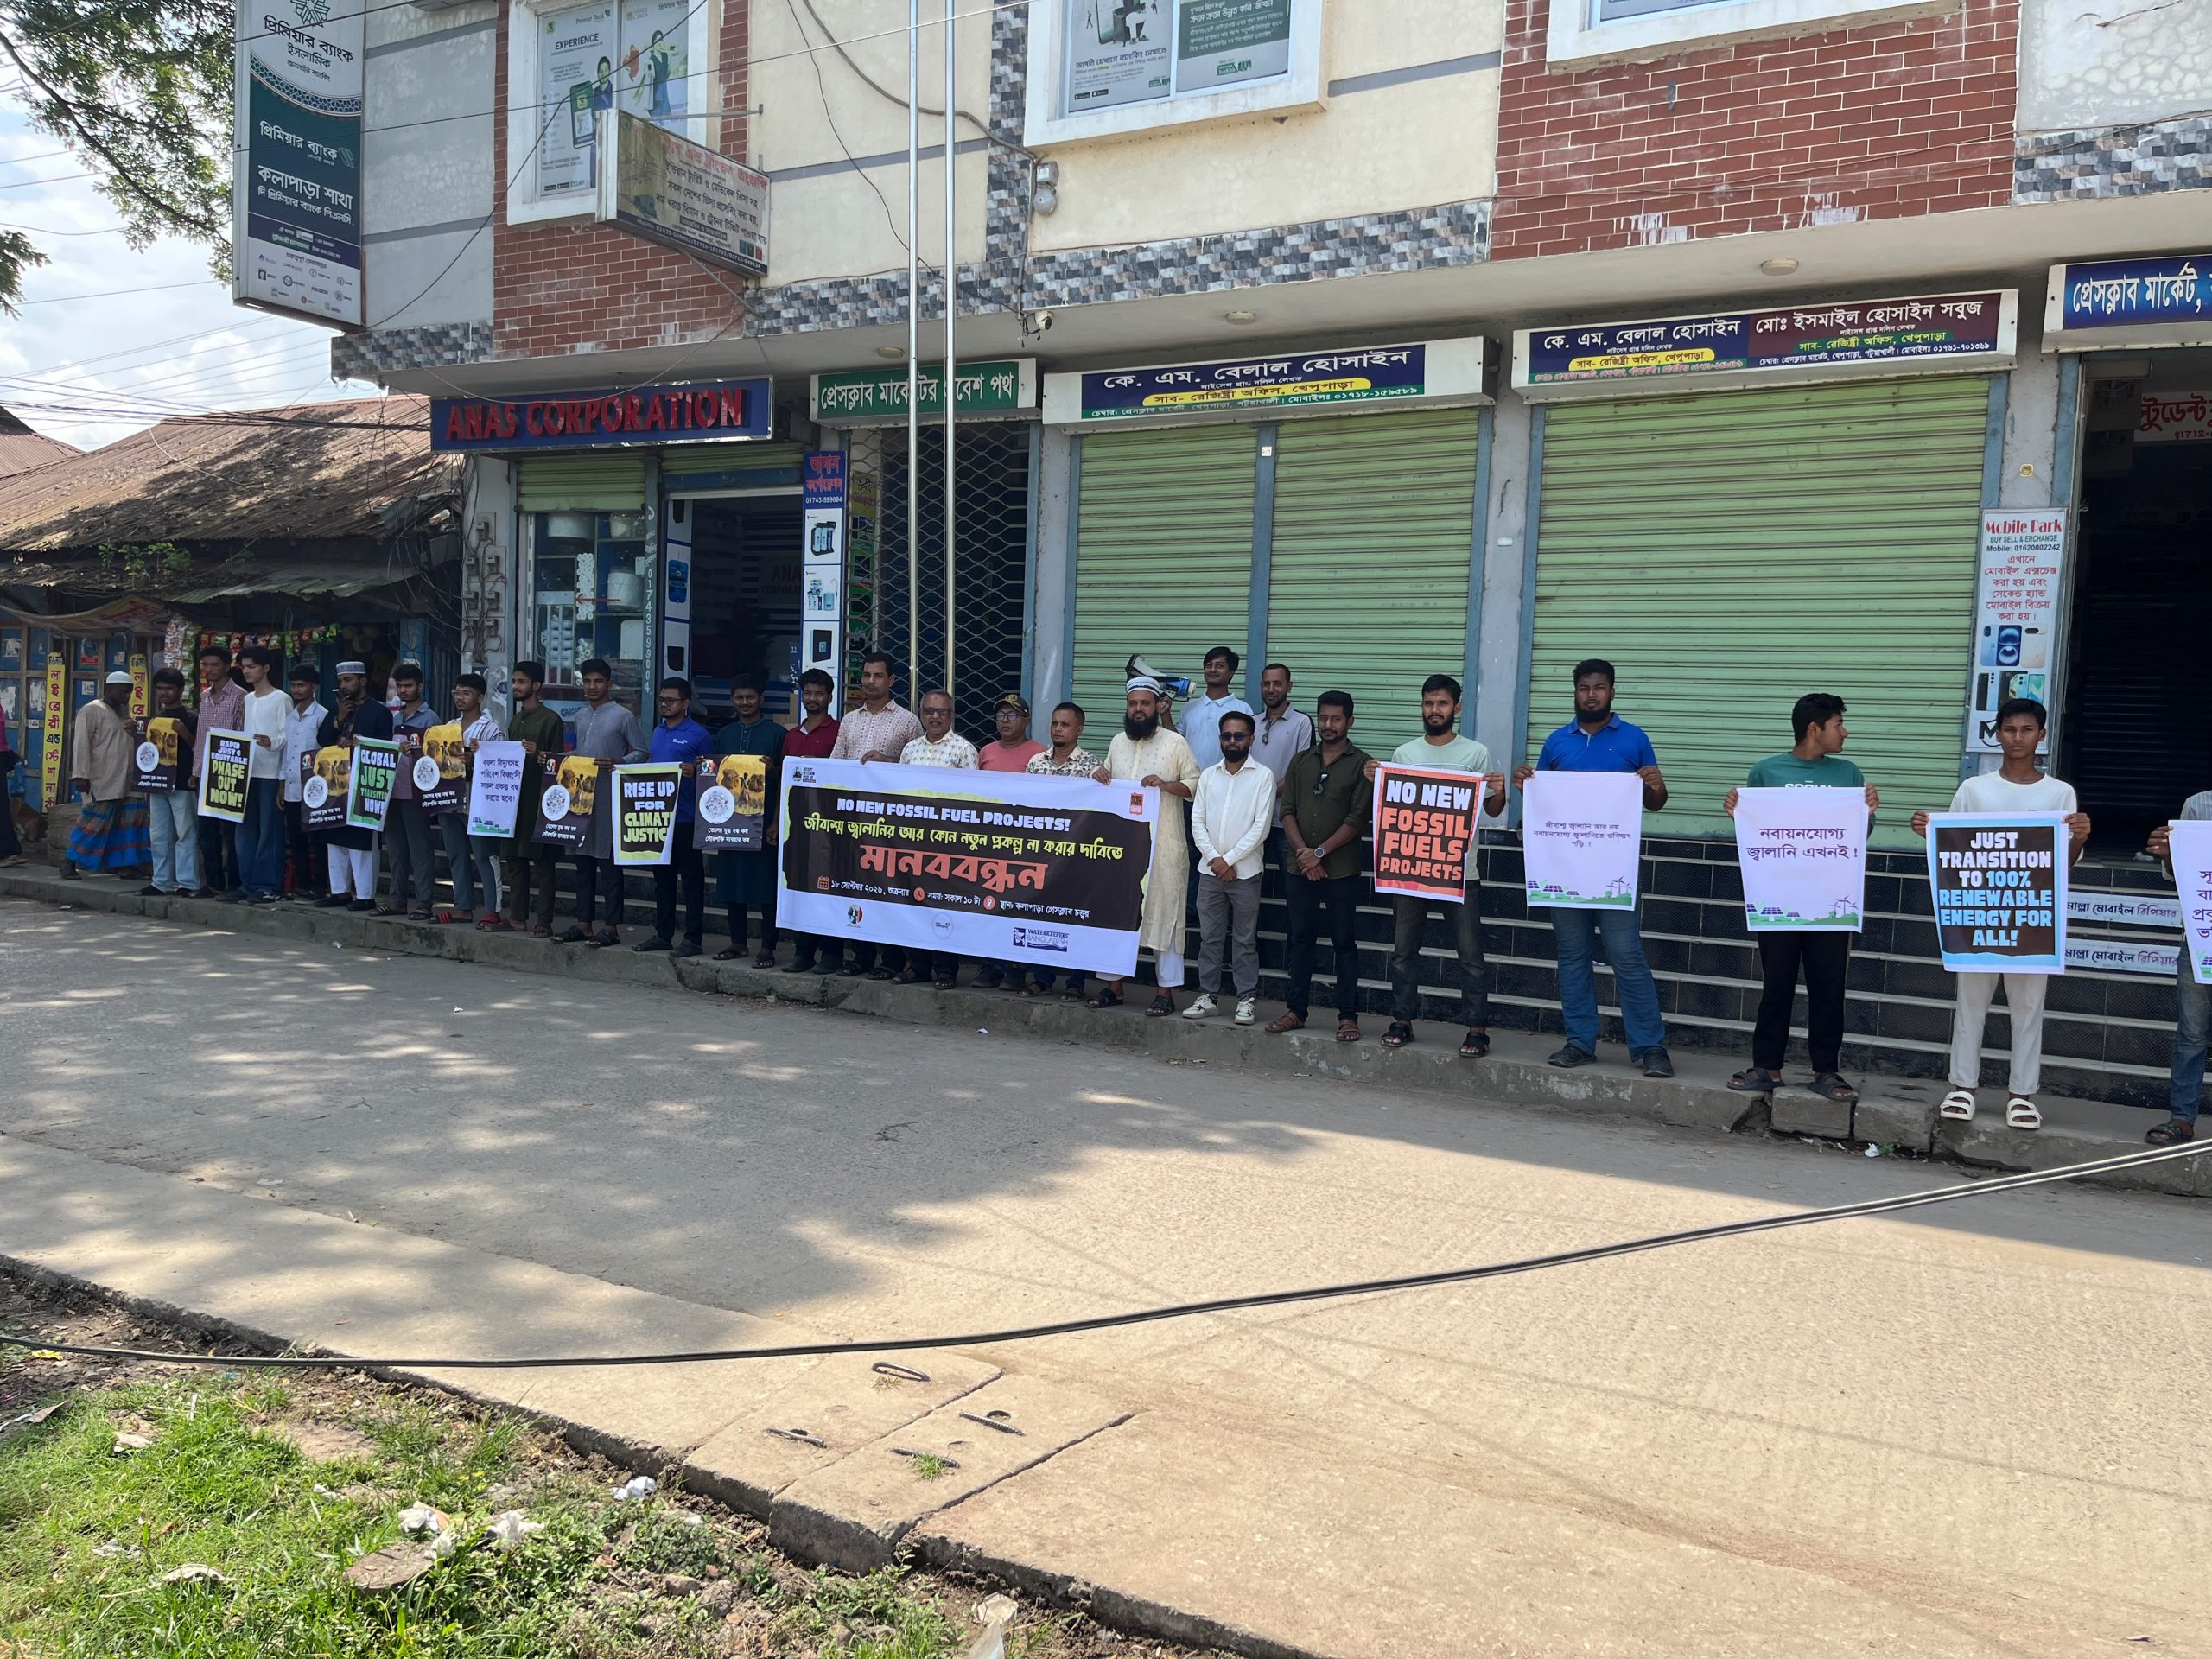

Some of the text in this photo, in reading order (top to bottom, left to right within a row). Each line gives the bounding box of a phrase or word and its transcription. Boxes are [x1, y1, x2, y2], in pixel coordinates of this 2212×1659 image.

[264, 15, 354, 62] প্রিমিয়ার ব্যাংক
[555, 34, 599, 50] EXPERIENCE
[287, 42, 331, 68] ইসলামিক
[259, 120, 303, 149] প্রিমিয়ার
[308, 141, 338, 161] ব্যাংক
[258, 165, 353, 210] কলাপাড়া শাখা
[258, 186, 322, 214] দি প্রিমিয়ার ব্যাংক
[2074, 262, 2202, 315] প্রেসক্লাব মার্কেট,
[1756, 300, 1983, 334] মোঃ ইসমাইল হোসাইন সবুজ
[1544, 318, 1741, 350] কে. এম. বেলাল হোসাইন
[1901, 330, 1946, 346] খেপুপাড়া
[1664, 351, 1705, 364] খেপুপাড়া
[1103, 350, 1412, 389] কে. এম. বেলাল হোসাইন
[821, 382, 875, 410] প্রেসক্লাব
[990, 370, 1014, 401] পথ
[1292, 380, 1355, 394] খেপুপাড়া
[444, 387, 744, 441] ANAS CORPORATION
[1986, 518, 2063, 534] Mobile Park
[2007, 555, 2037, 563] এখানে
[1984, 565, 2020, 575] মোবাইল
[1993, 578, 2047, 588] করা হয় এবং
[1992, 589, 2046, 599] সেকেন্ড হ্যান্ড
[1986, 599, 2050, 610] মোবাইল বিক্রয়
[1998, 612, 2031, 621] করা হয়
[218, 747, 236, 755] JUST
[219, 739, 240, 748] RAPID
[211, 752, 248, 765] EQUITABLE
[360, 749, 397, 768] GLOBAL
[212, 760, 245, 779] PHASE
[360, 766, 396, 789] JUST
[217, 775, 238, 792] OUT
[624, 781, 675, 798] RISE UP
[210, 788, 244, 808] NOW!
[360, 788, 388, 800] TRANSITIO
[1386, 779, 1472, 810] NO NEW
[634, 800, 665, 810] FOR
[624, 812, 671, 827] CLIMAT
[836, 798, 1071, 832] NO NEW FOSSIL FUEL PROJECTS!
[1381, 806, 1469, 839] FOSSIL
[623, 827, 667, 842] JUSTIC
[804, 811, 1124, 860] জীবাশ্ম জ্বালানির আর কোন নতুন প্রকল্প না করার দাবিতে
[1758, 827, 1847, 841] নবায়নযোগ্য
[1969, 831, 2019, 849] JUST
[1383, 831, 1464, 862] FUELS
[1746, 843, 1798, 861] জ্বালানি
[859, 844, 1049, 893] মানববন্ধন
[1379, 856, 1463, 881] PROJECTS
[1938, 851, 2051, 868] TRANSITION
[1958, 870, 2031, 887] TO 100%
[944, 893, 963, 904] সকাল
[963, 895, 973, 905] ১০
[974, 895, 982, 906] টা
[1015, 901, 1045, 914] কলাপাড়া
[1046, 905, 1073, 917] প্রেসক্লাব
[1938, 889, 2053, 907] RENEWABLE
[1940, 909, 2052, 927] ENERGY FOR
[2092, 902, 2134, 916] মোবাইল
[1972, 929, 2019, 947] ALL!
[2091, 950, 2135, 963] মোবাইল
